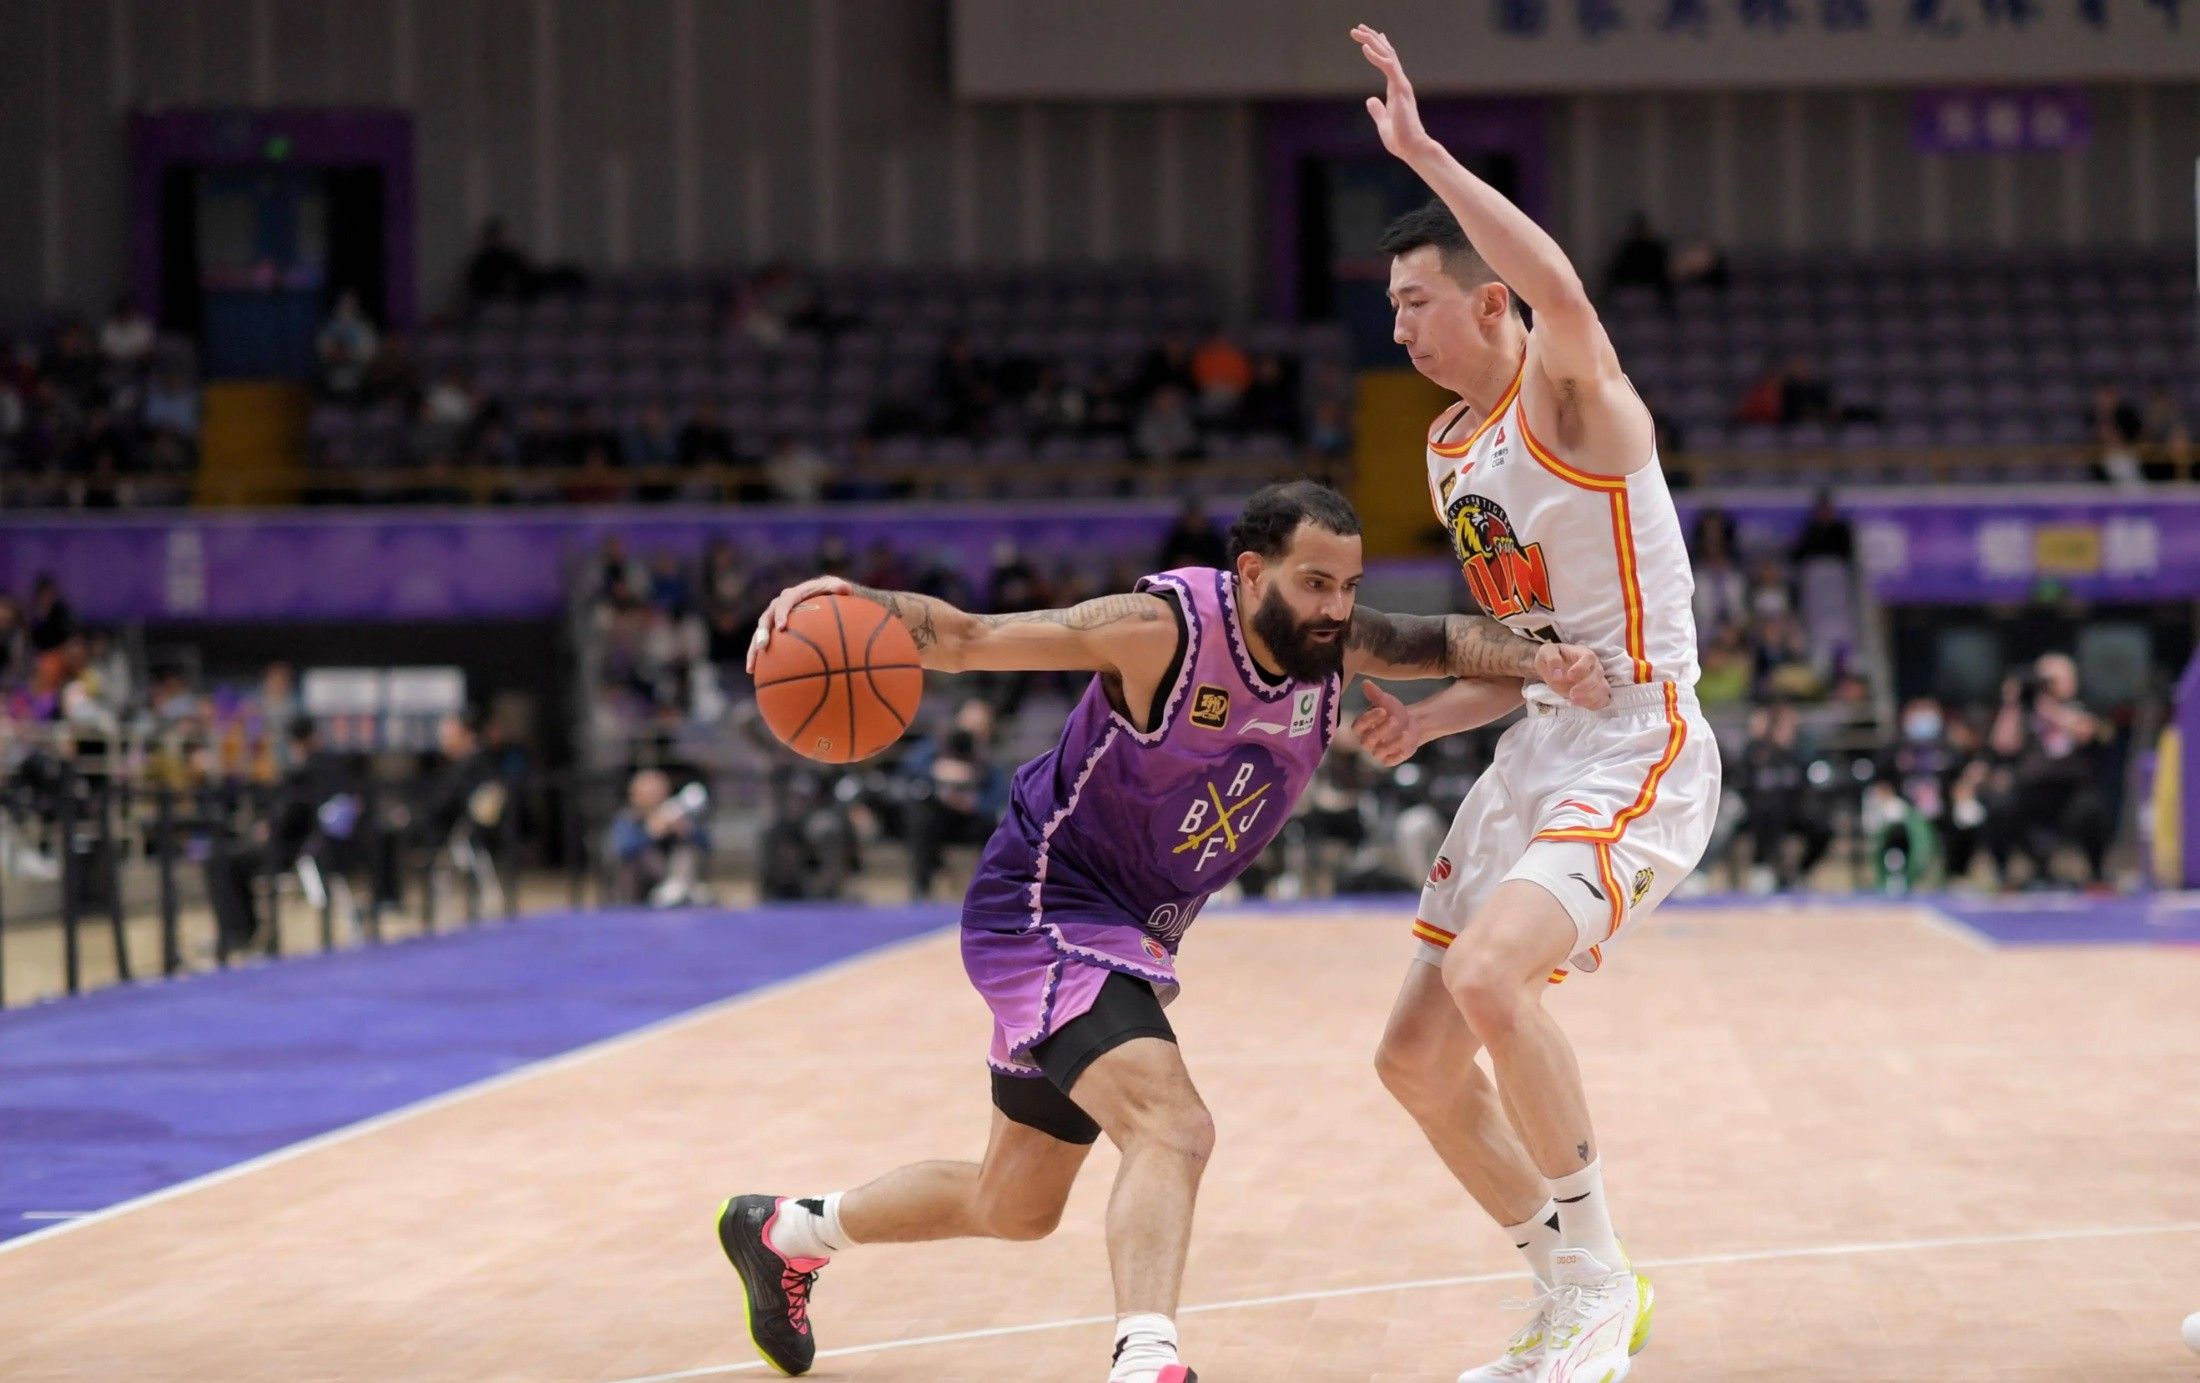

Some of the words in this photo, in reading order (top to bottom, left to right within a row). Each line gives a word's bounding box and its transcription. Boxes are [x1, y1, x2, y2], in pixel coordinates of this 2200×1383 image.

[1225, 762, 1254, 797] R
[1177, 798, 1209, 833] B
[1238, 799, 1267, 833] J
[1193, 836, 1224, 872] F
